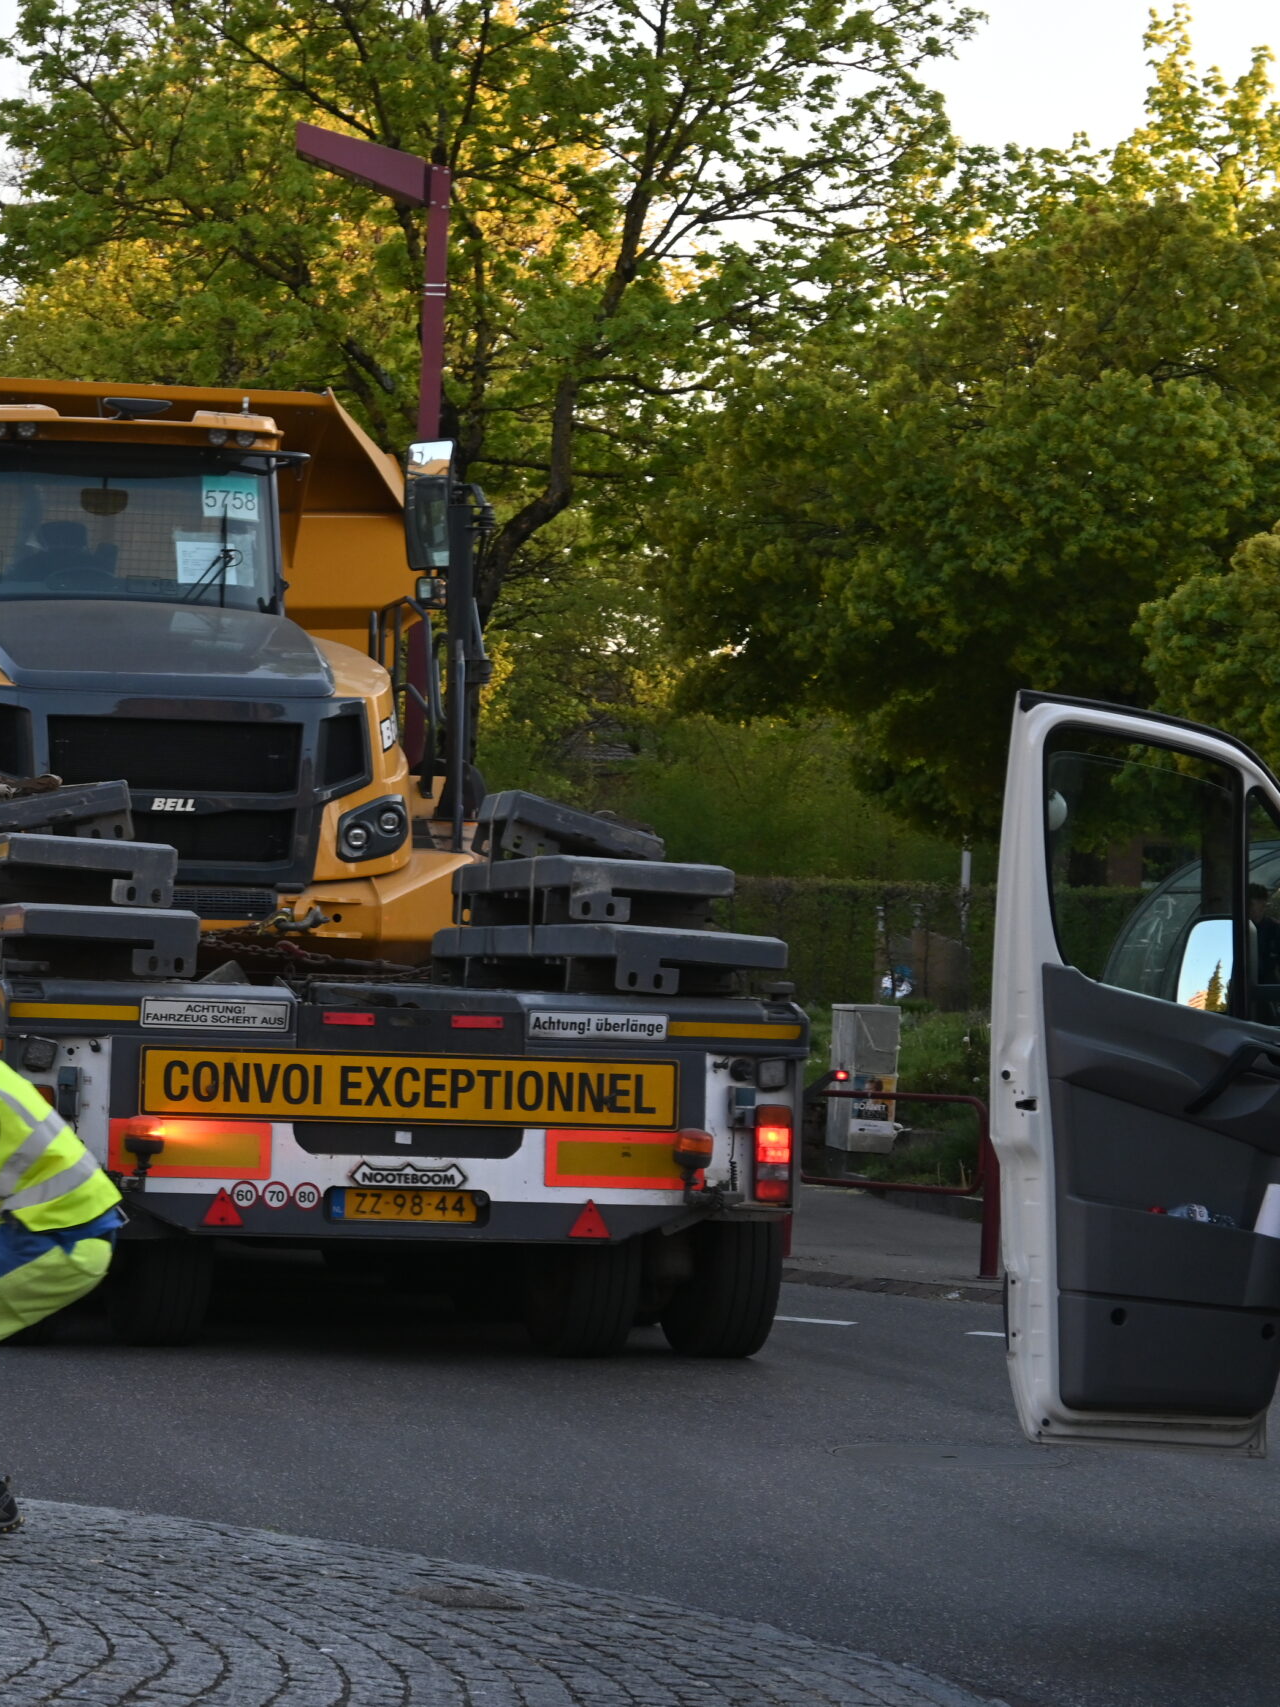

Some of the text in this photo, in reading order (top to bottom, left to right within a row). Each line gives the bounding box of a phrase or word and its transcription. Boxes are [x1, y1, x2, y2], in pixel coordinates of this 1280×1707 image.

[204, 489, 256, 511] 5758
[151, 797, 196, 811] BELL
[185, 1004, 246, 1014] ACHTUNG!
[145, 1013, 285, 1026] FAHRZEUG SCHERT AUS
[532, 1016, 664, 1037] Achtung! überlänge
[162, 1059, 657, 1115] CONVOI EXCEPTIONNEL
[361, 1171, 456, 1186] NOOTEBOOM
[236, 1189, 254, 1202] 60
[268, 1190, 285, 1203] 70
[298, 1191, 315, 1203] 80
[332, 1206, 344, 1215] NL
[354, 1191, 466, 1218] ZZ-98-44
